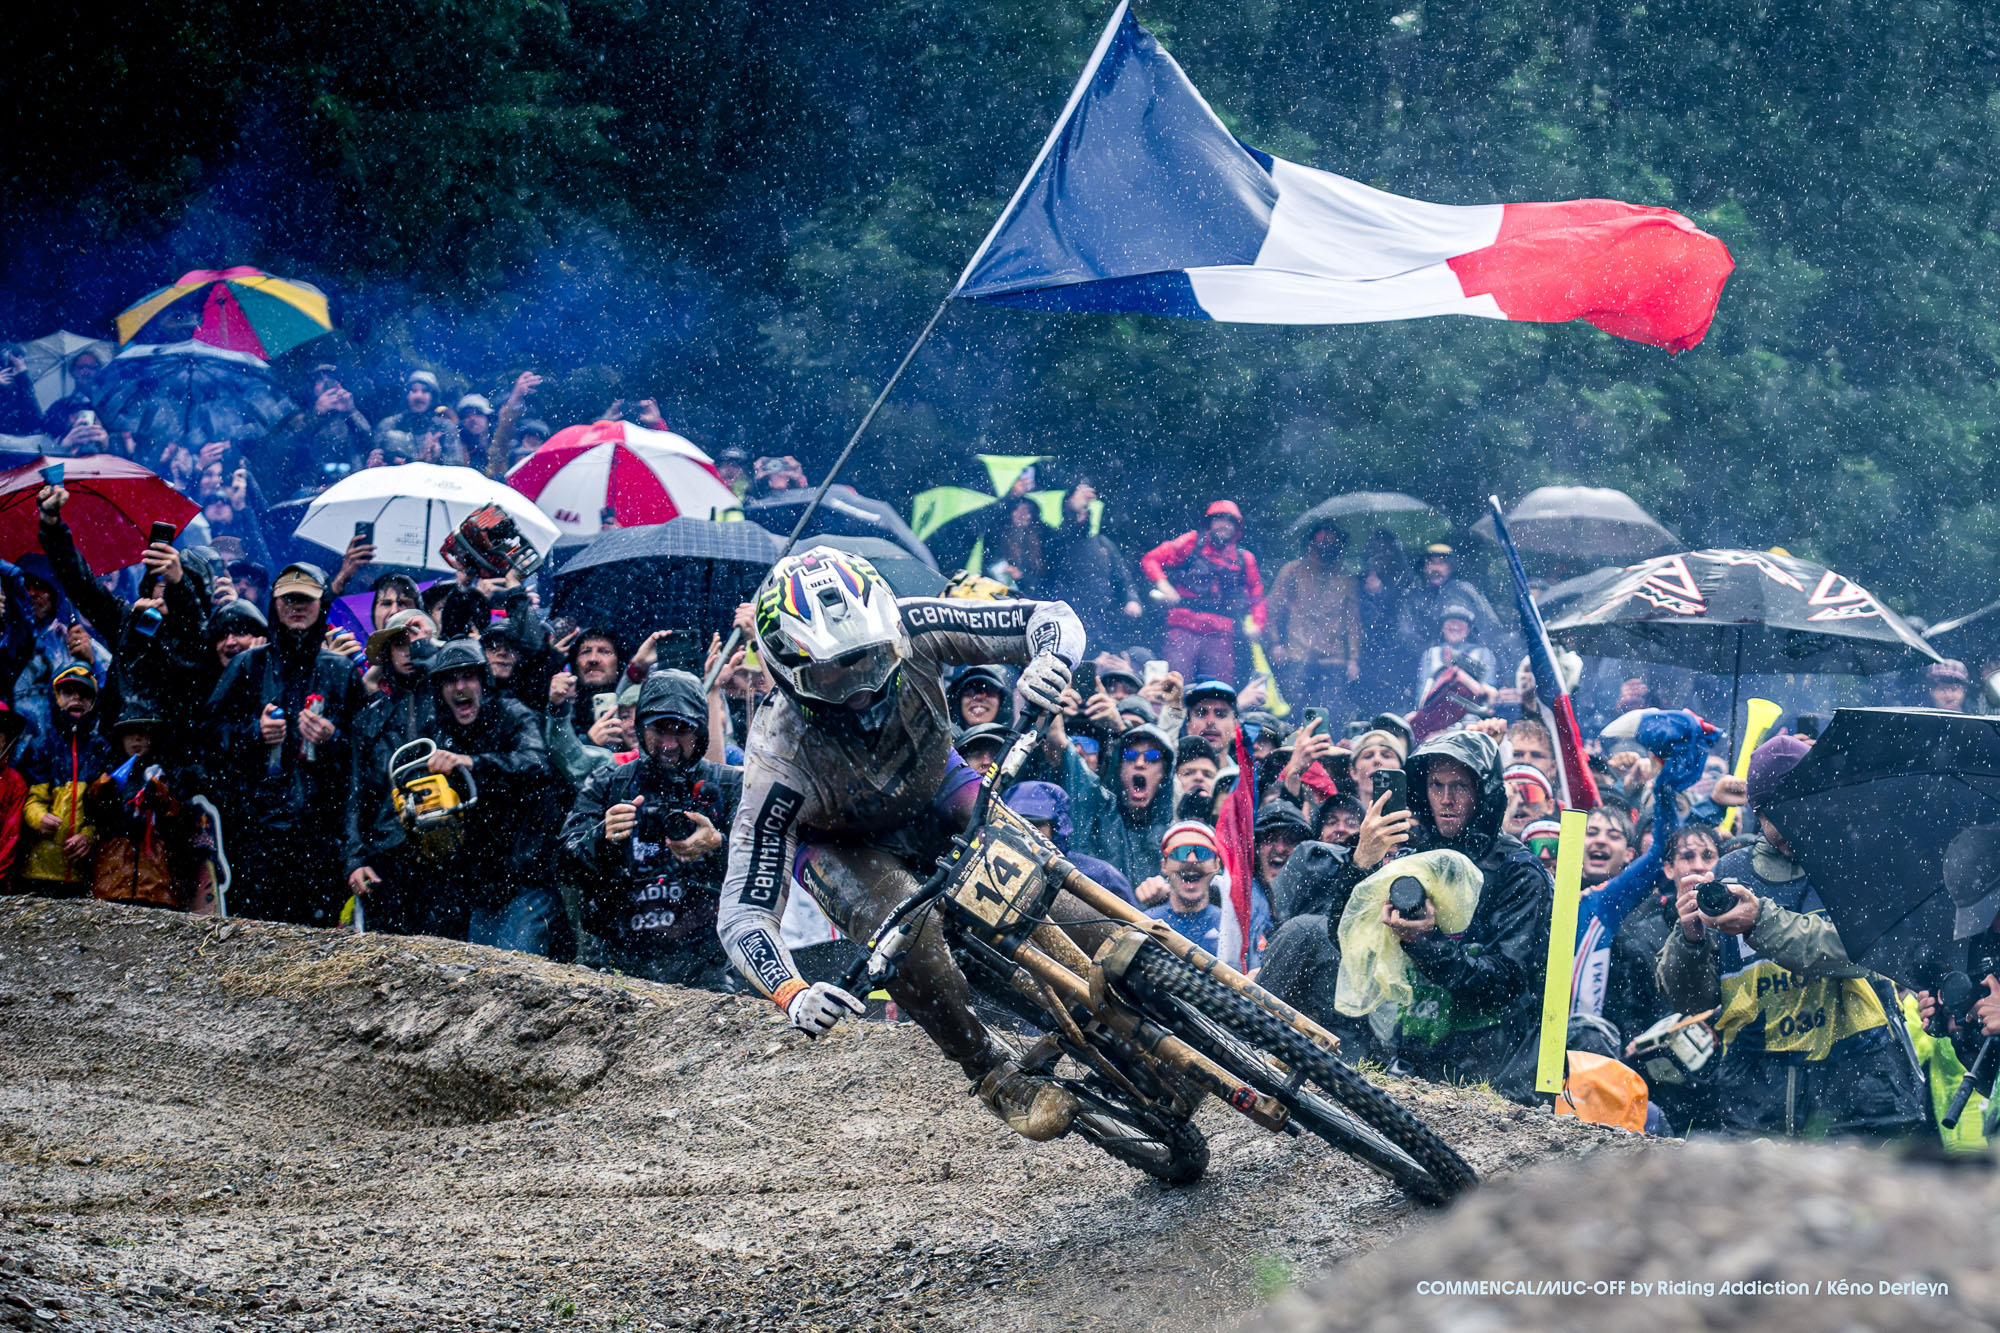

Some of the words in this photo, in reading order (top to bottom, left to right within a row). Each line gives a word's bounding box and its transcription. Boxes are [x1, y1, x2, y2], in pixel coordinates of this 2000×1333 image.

[809, 577, 834, 588] BELL
[908, 606, 1026, 628] COMMENCAL
[975, 856, 1022, 905] 14
[631, 911, 676, 931] 030
[1780, 1007, 1826, 1037] 036
